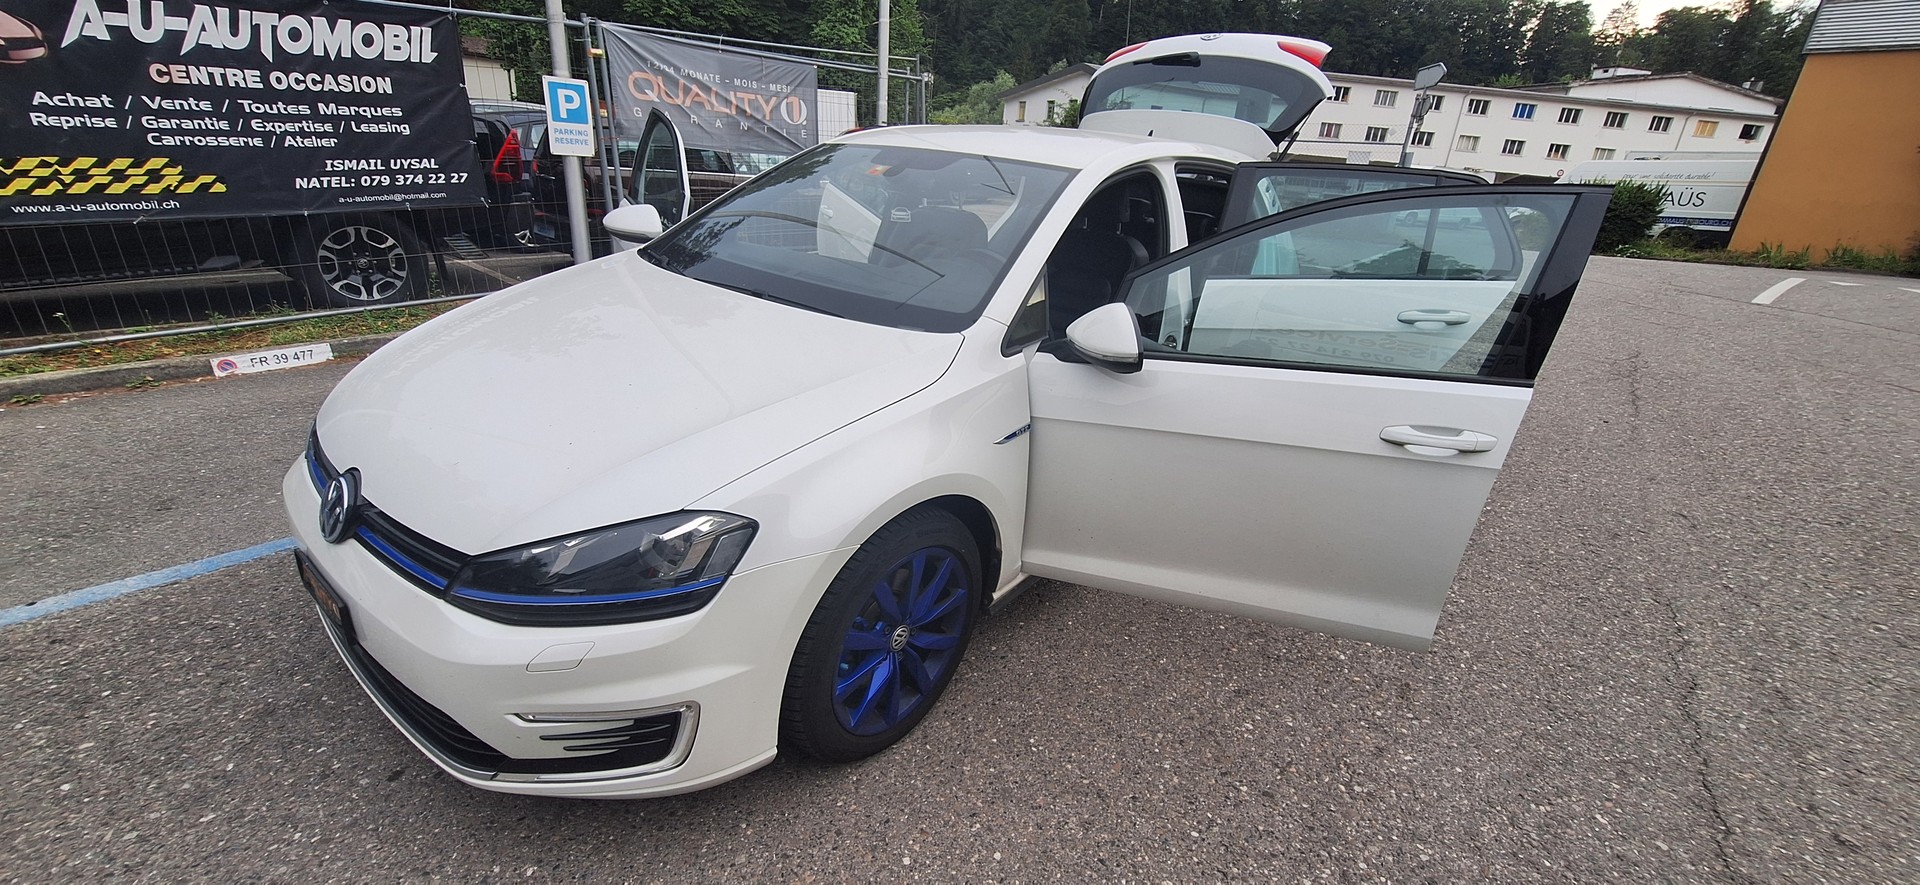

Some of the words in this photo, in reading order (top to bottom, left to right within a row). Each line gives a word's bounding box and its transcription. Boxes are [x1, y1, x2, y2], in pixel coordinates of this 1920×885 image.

[61, 0, 438, 63] A-U-AUTOMOBIL
[149, 63, 264, 89] CENTRE
[269, 71, 393, 94] OCCASION
[680, 68, 721, 83] MONATE
[734, 78, 758, 89] MOIS
[769, 84, 792, 93] MESI
[31, 91, 115, 108] Achat
[141, 95, 213, 112] Vente
[237, 99, 311, 115] Toutes
[317, 102, 403, 118] Marques
[556, 88, 580, 119] P
[627, 71, 777, 121] QUALITY
[29, 112, 118, 129] Reprise
[141, 115, 230, 131] Garantie
[250, 118, 334, 135] Expertise
[351, 121, 411, 135] Leasing
[554, 127, 589, 138] PARKING
[147, 132, 264, 147] Carrosserie
[284, 135, 338, 148] Atelier
[325, 159, 385, 171] ISMAIL
[390, 158, 439, 170] UYSAL
[295, 177, 356, 189] NATEL:
[360, 175, 391, 187] 079
[395, 174, 424, 186] 374
[428, 174, 446, 184] 22
[450, 173, 468, 184] 27
[11, 199, 181, 214] www.a-u-automobil.ch
[338, 192, 447, 203] a-u-automobil@hotmail.com
[273, 353, 289, 365] 39
[293, 349, 314, 361] 477
